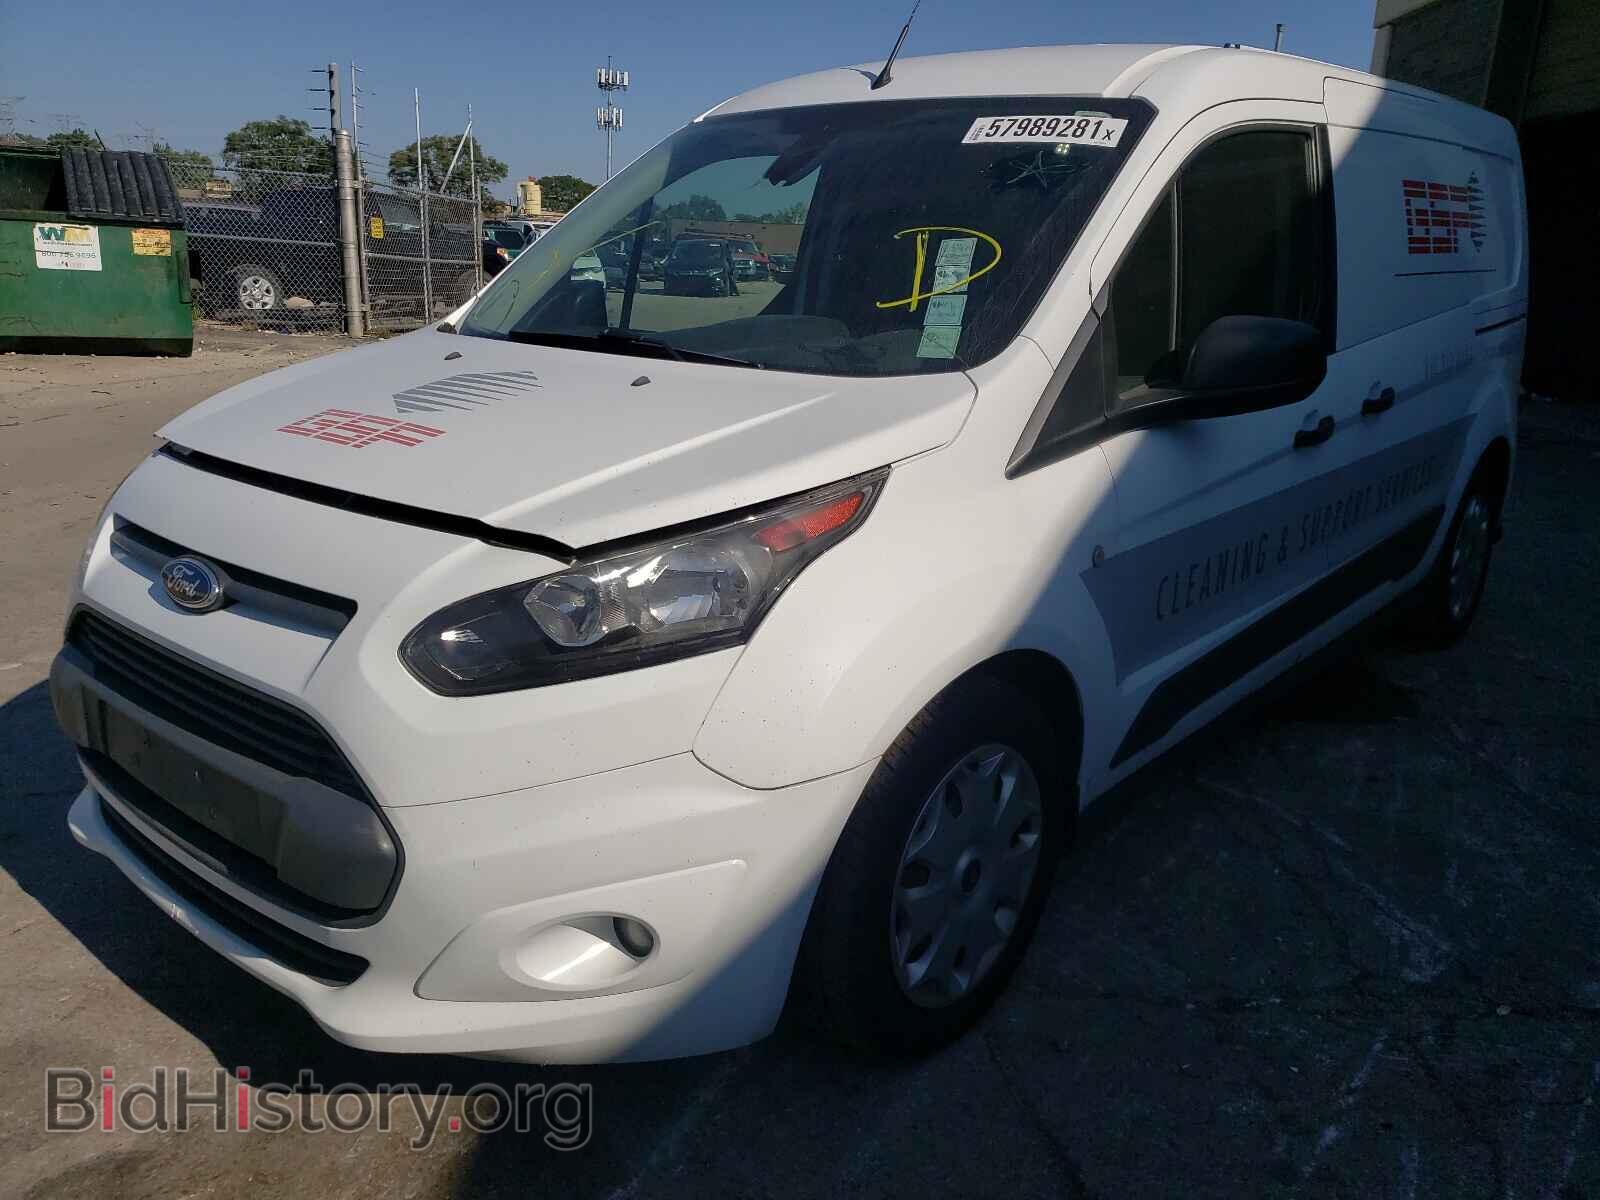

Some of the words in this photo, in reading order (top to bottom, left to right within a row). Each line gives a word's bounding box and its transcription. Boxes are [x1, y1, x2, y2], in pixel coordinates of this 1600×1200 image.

[167, 565, 201, 598] Ford
[1155, 532, 1269, 621] CLEANING
[1276, 525, 1290, 563] &
